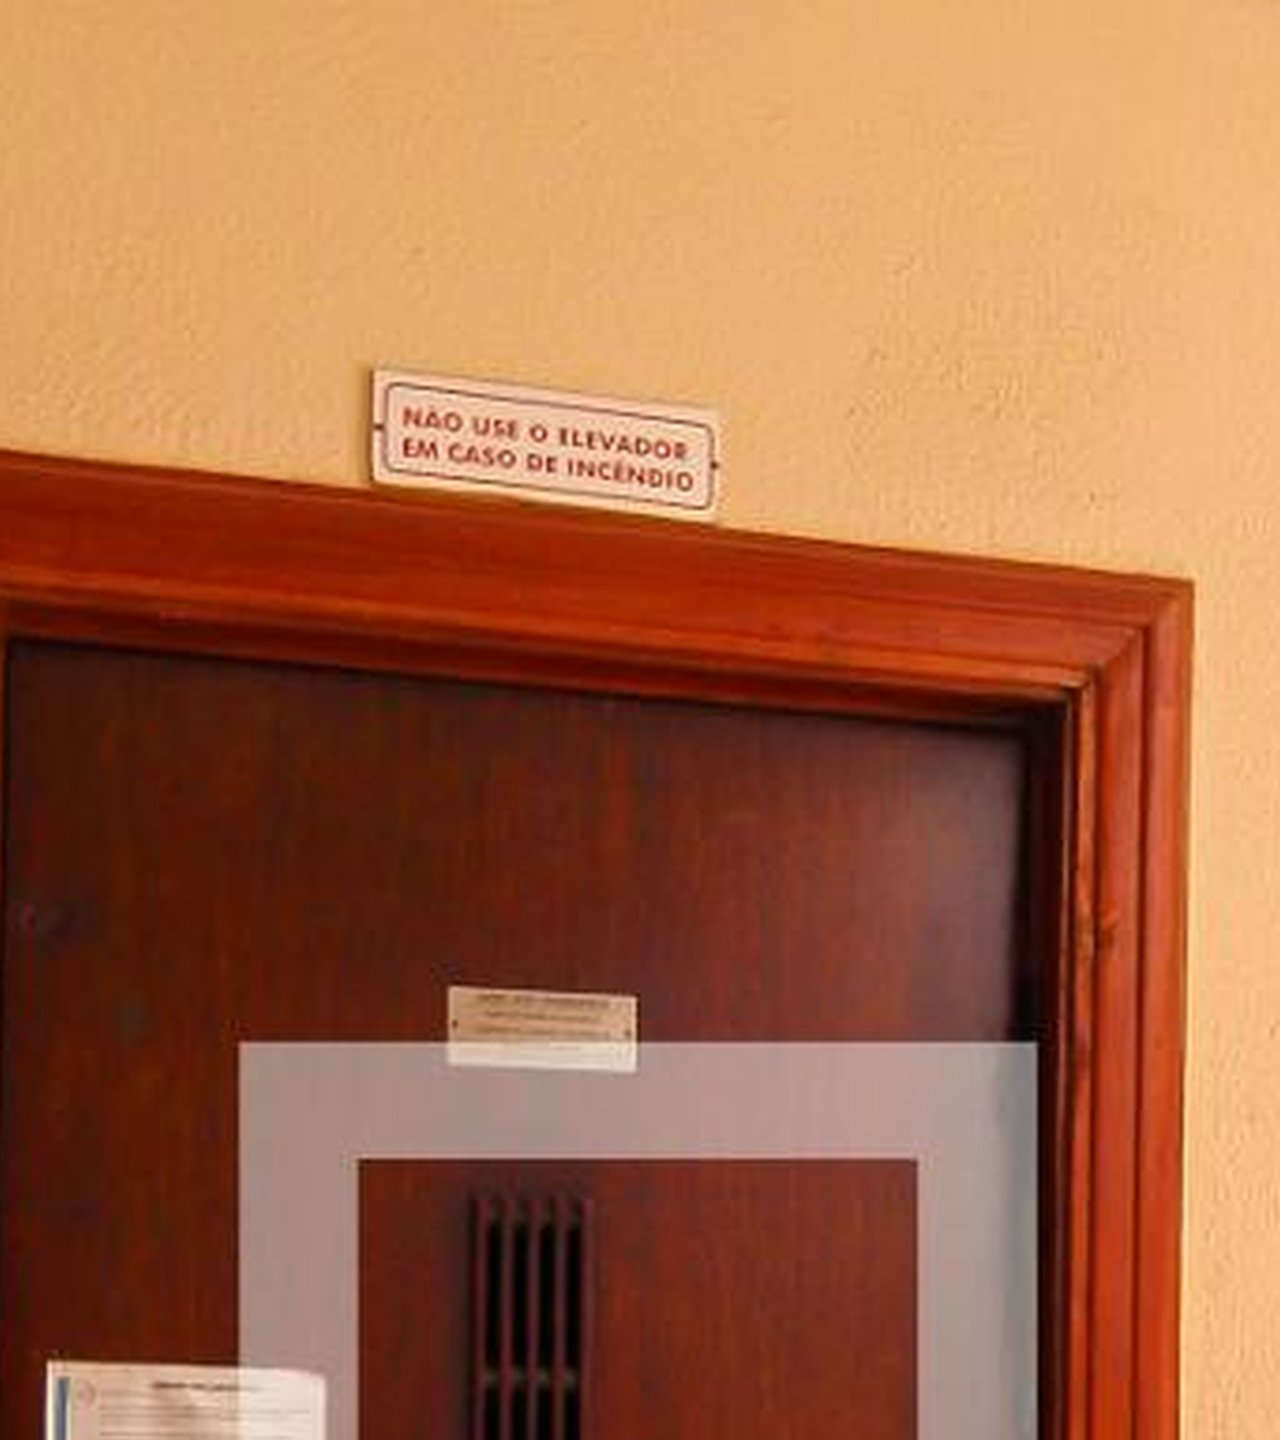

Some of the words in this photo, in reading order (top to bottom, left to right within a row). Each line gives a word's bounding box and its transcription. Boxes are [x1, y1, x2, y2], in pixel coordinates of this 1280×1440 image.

[402, 404, 463, 433] NÃO
[472, 416, 518, 442] USE
[529, 423, 548, 444] O
[559, 426, 687, 459] ELEVADOR
[402, 438, 439, 461] EM
[448, 441, 517, 469] CASO
[526, 453, 557, 474] DE
